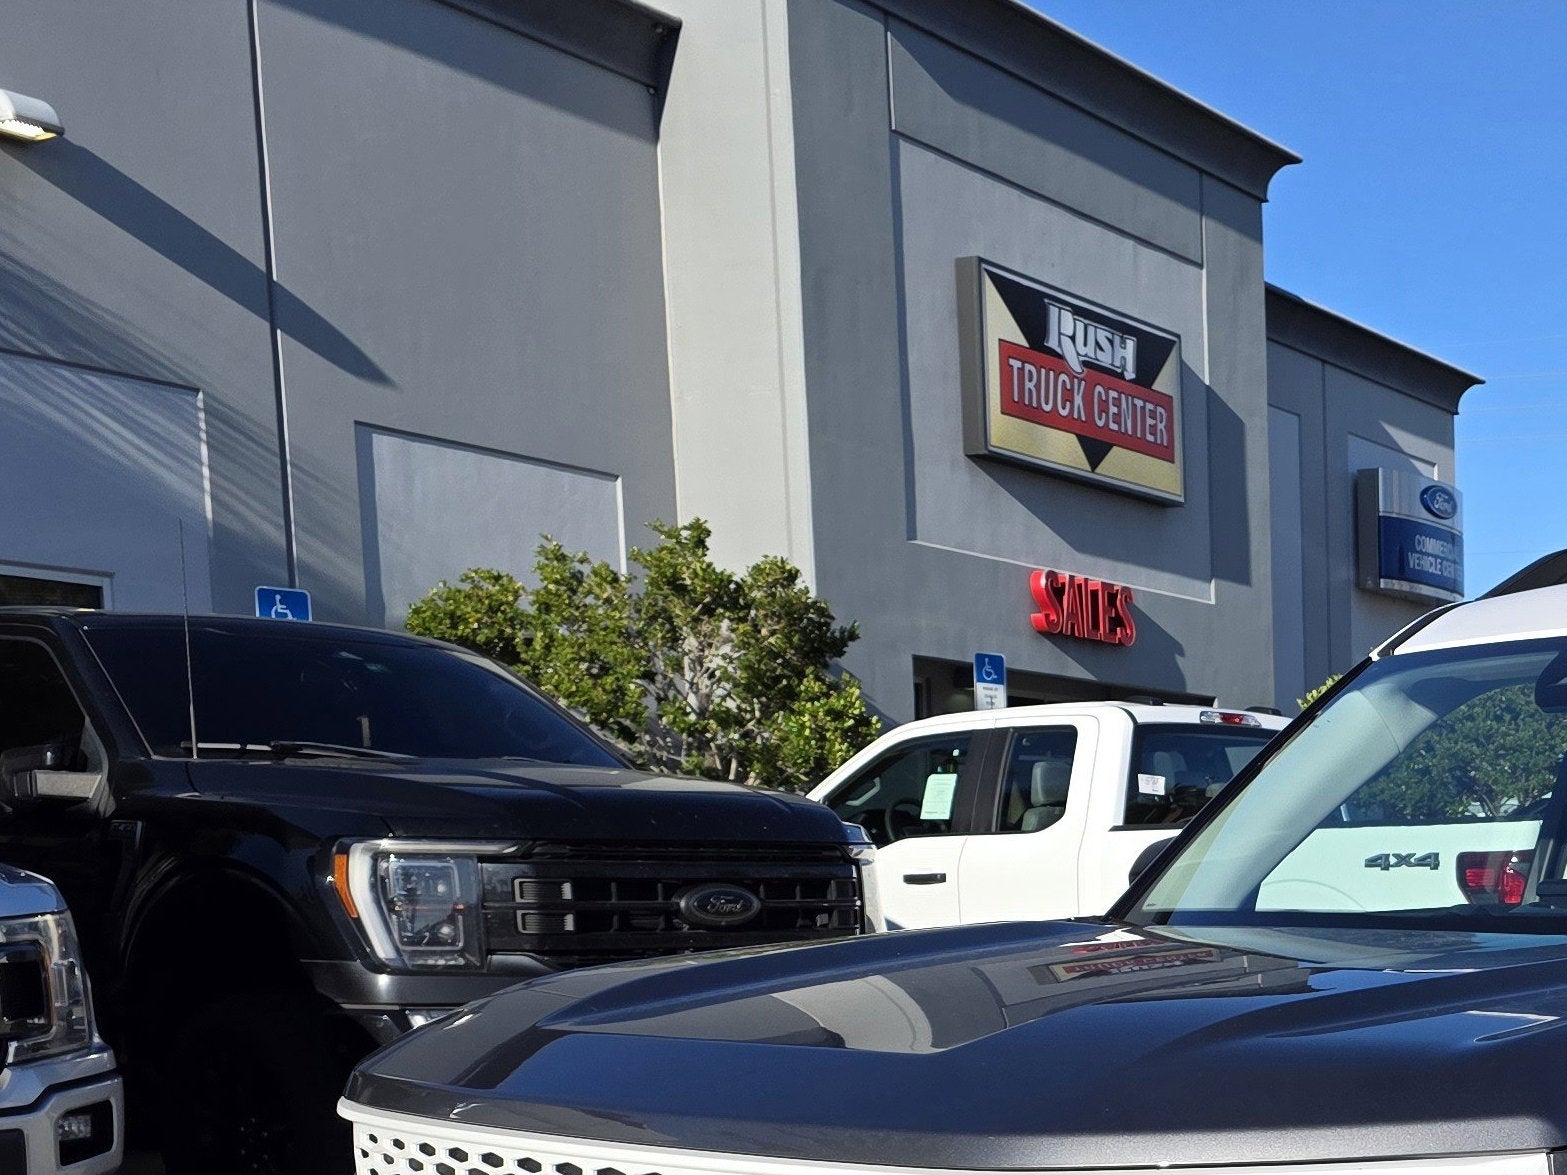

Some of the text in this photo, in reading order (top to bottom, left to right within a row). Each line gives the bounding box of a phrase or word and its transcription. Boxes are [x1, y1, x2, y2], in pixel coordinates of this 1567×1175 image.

[1044, 298, 1137, 381] RUSH
[1008, 357, 1168, 447] TRUCK CENTER
[1408, 552, 1442, 574] VEHICLE
[1030, 569, 1137, 647] SALES
[707, 895, 744, 913] Ford
